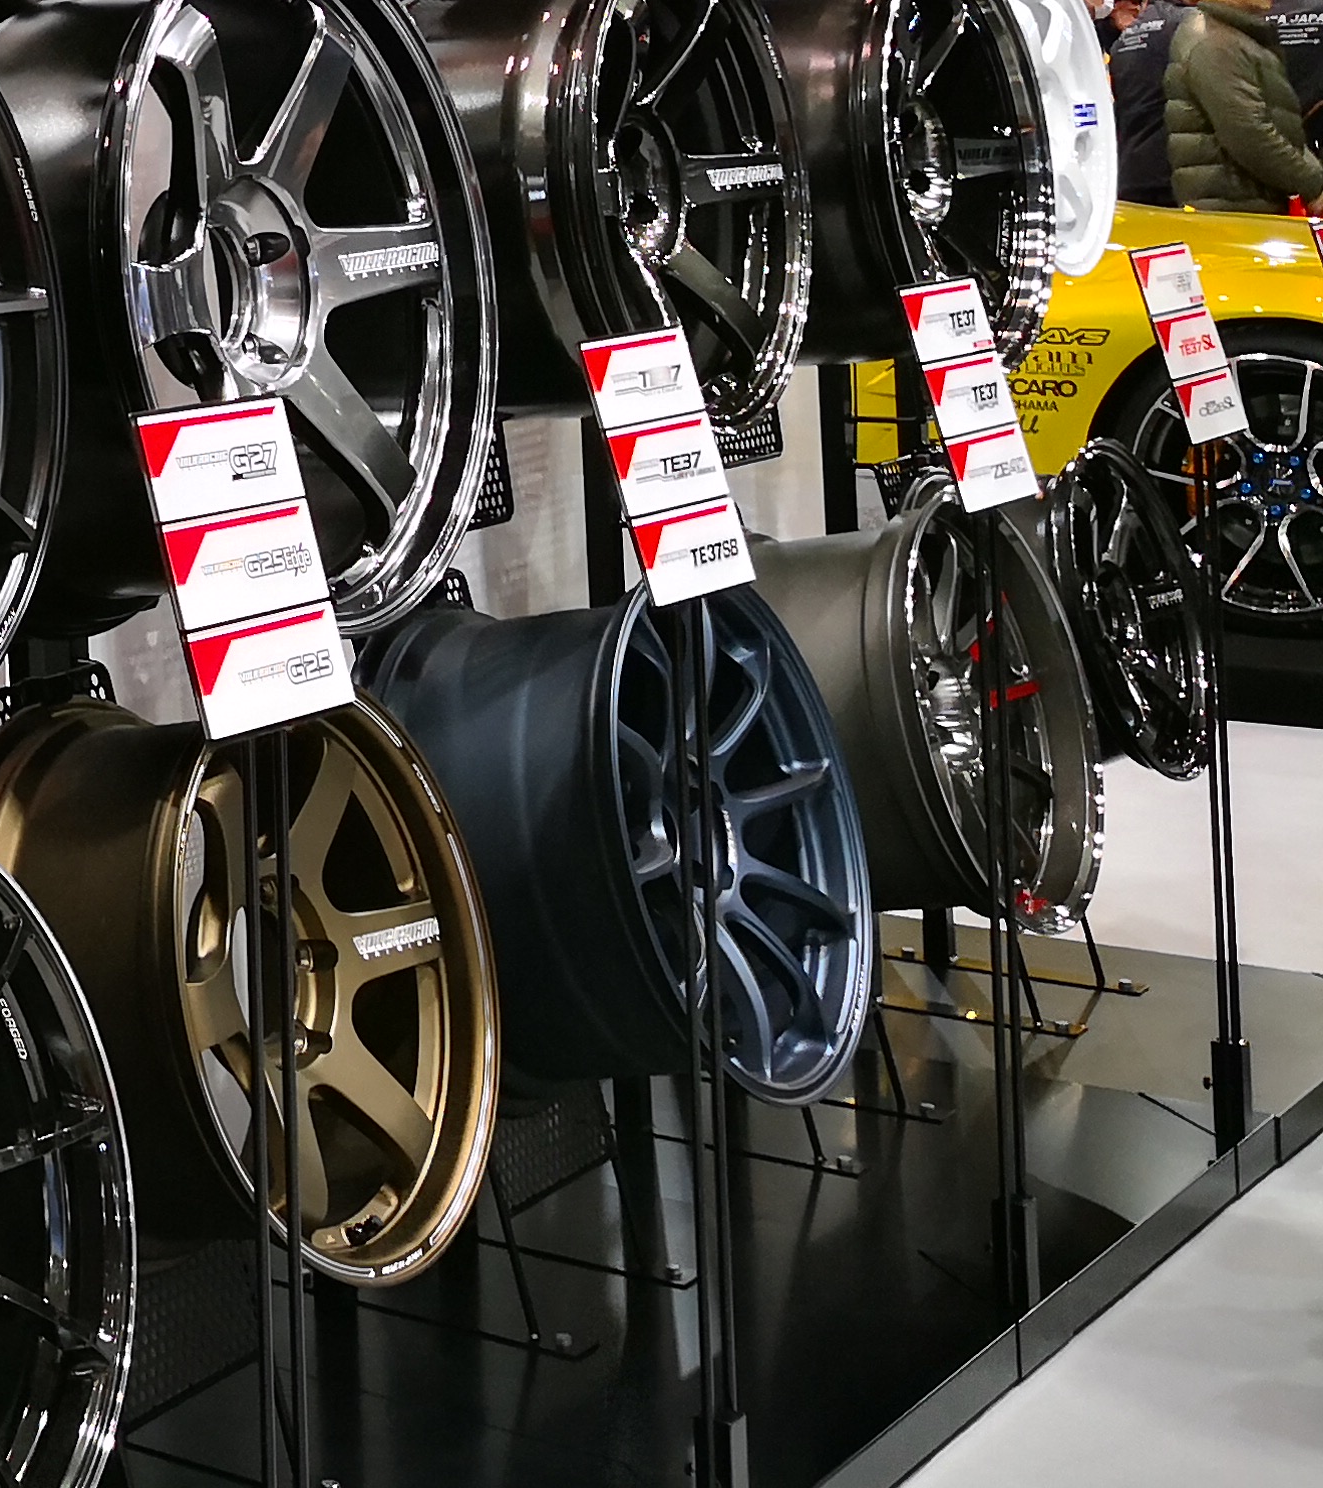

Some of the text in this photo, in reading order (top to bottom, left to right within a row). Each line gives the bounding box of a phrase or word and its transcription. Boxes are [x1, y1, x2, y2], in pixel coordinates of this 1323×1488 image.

[14, 157, 39, 222] FORGED
[949, 309, 976, 329] TE37
[1036, 327, 1111, 346] AYS
[972, 382, 998, 404] TE37
[1007, 378, 1077, 398] CARO
[229, 441, 277, 476] G27
[660, 450, 702, 475] TE37
[286, 648, 334, 685] G25
